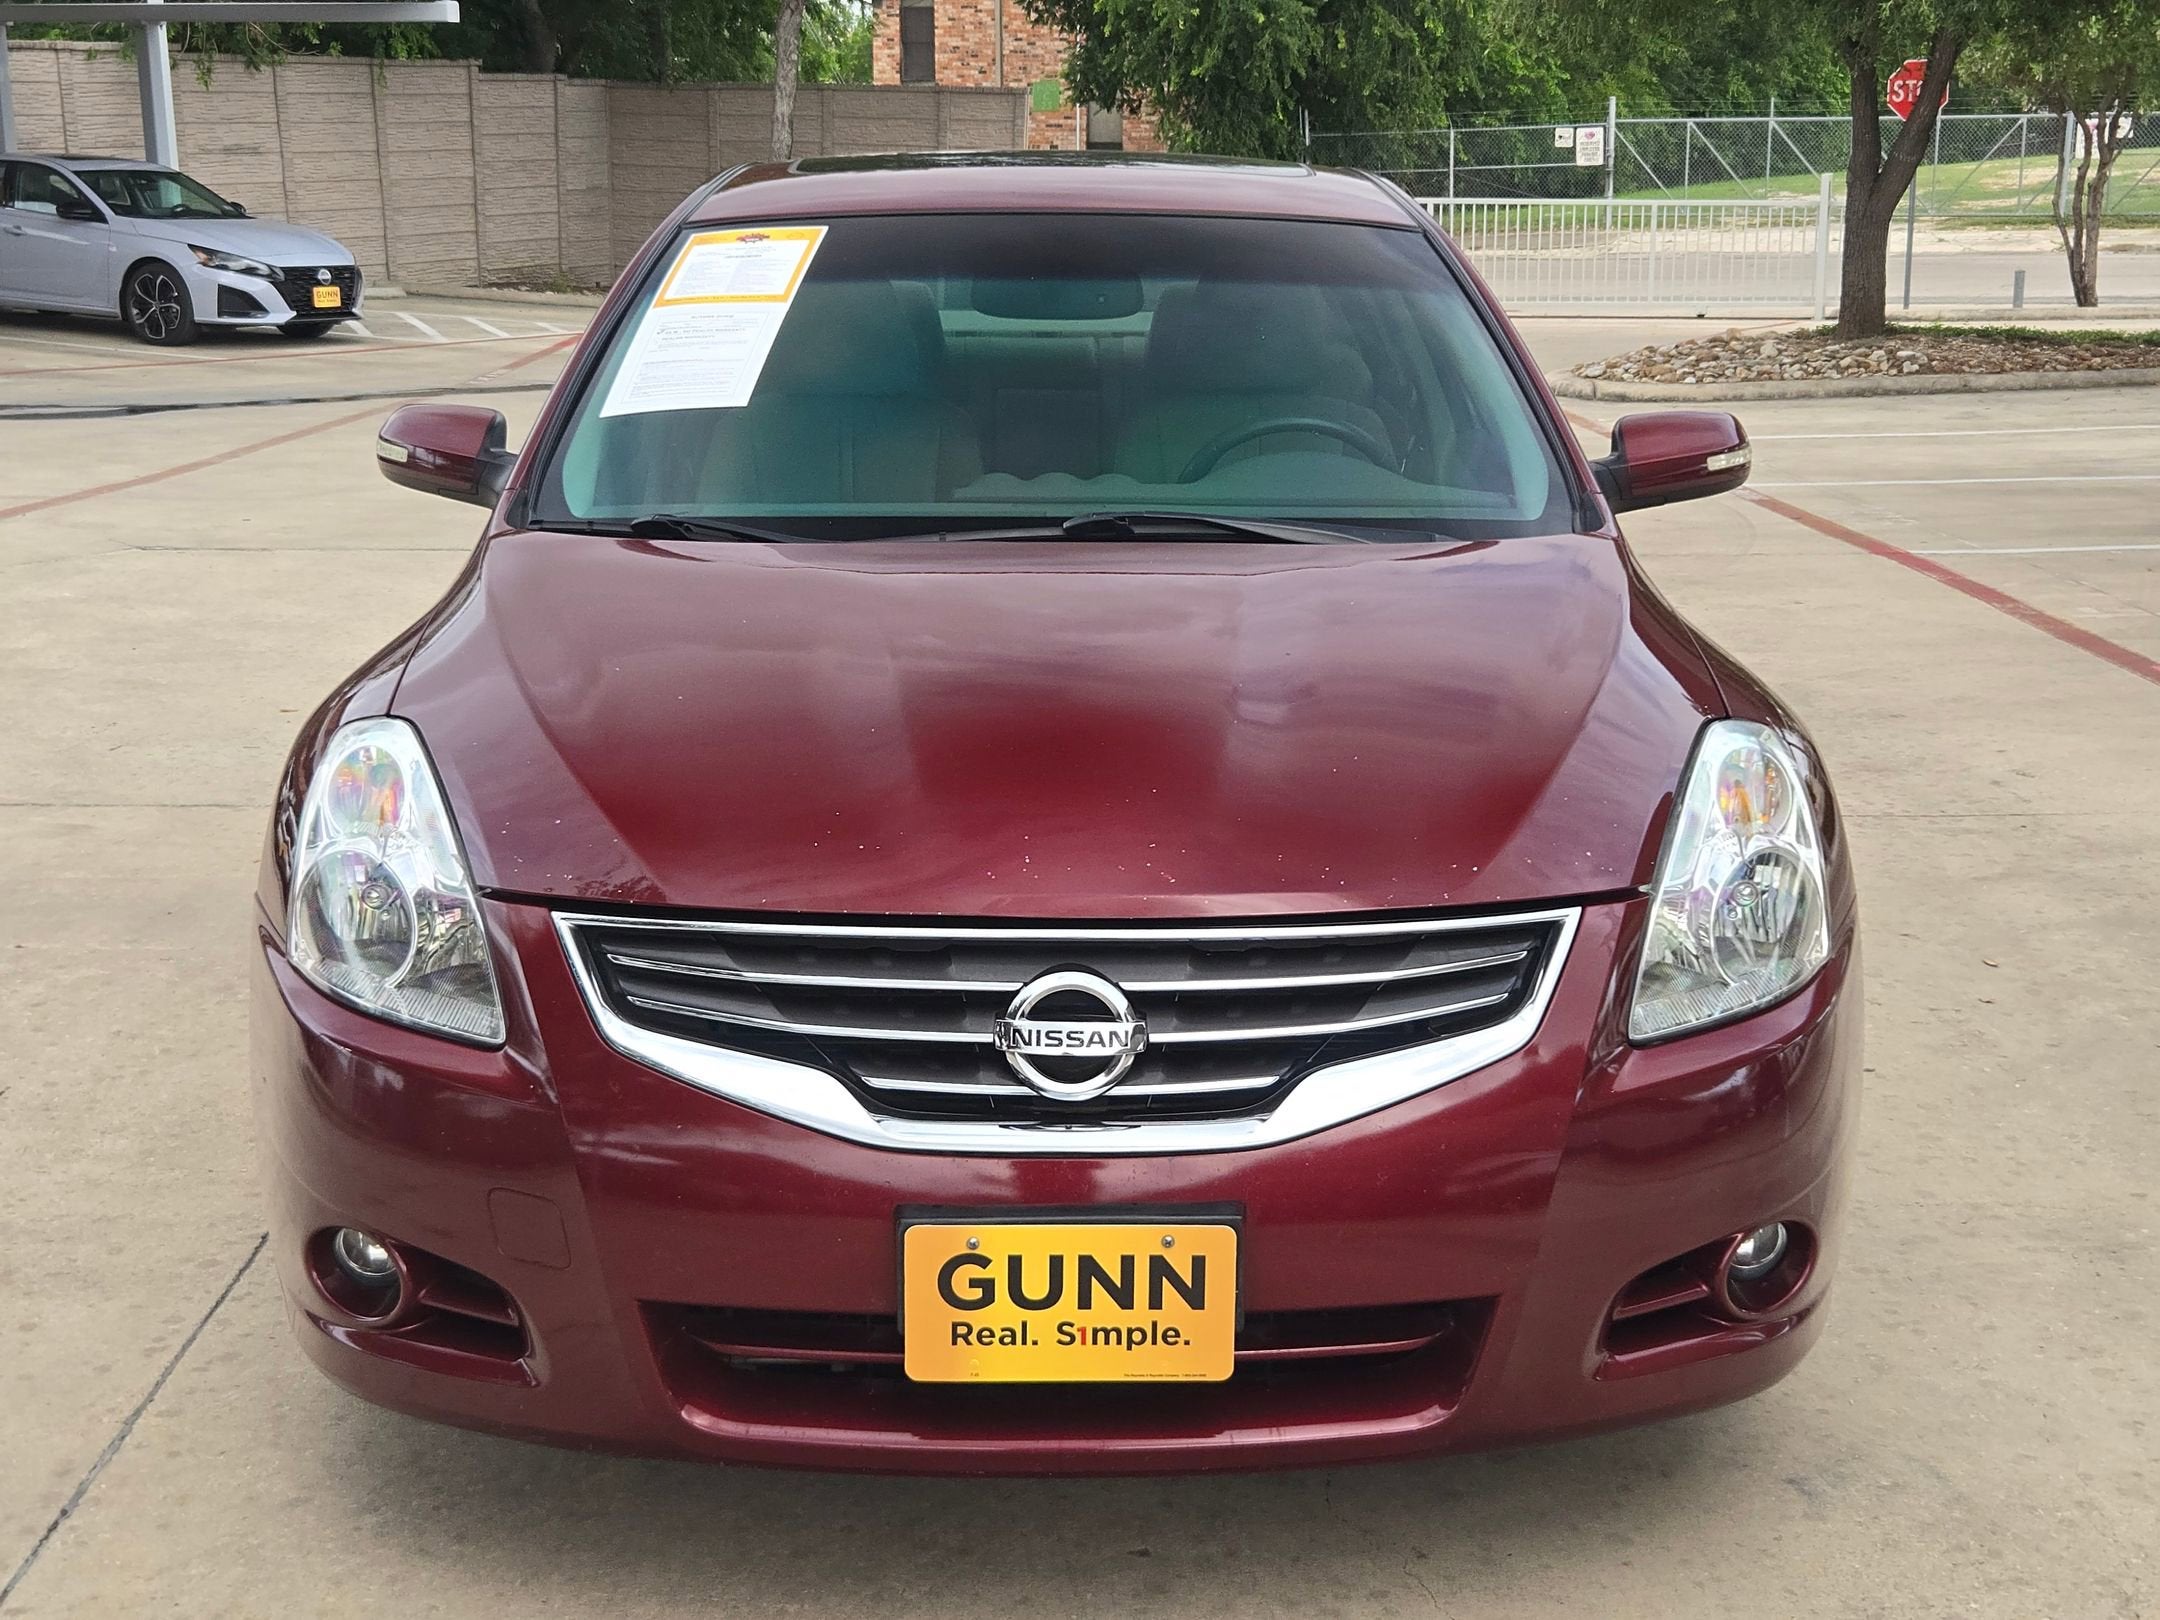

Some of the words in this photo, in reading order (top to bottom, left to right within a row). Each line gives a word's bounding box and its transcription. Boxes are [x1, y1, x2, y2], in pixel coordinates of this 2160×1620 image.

[1892, 80, 1923, 102] ST
[316, 290, 338, 298] GUNN
[1011, 1029, 1129, 1048] NISSAN
[937, 1252, 1206, 1311] GUNN
[951, 1320, 1039, 1346] Real.
